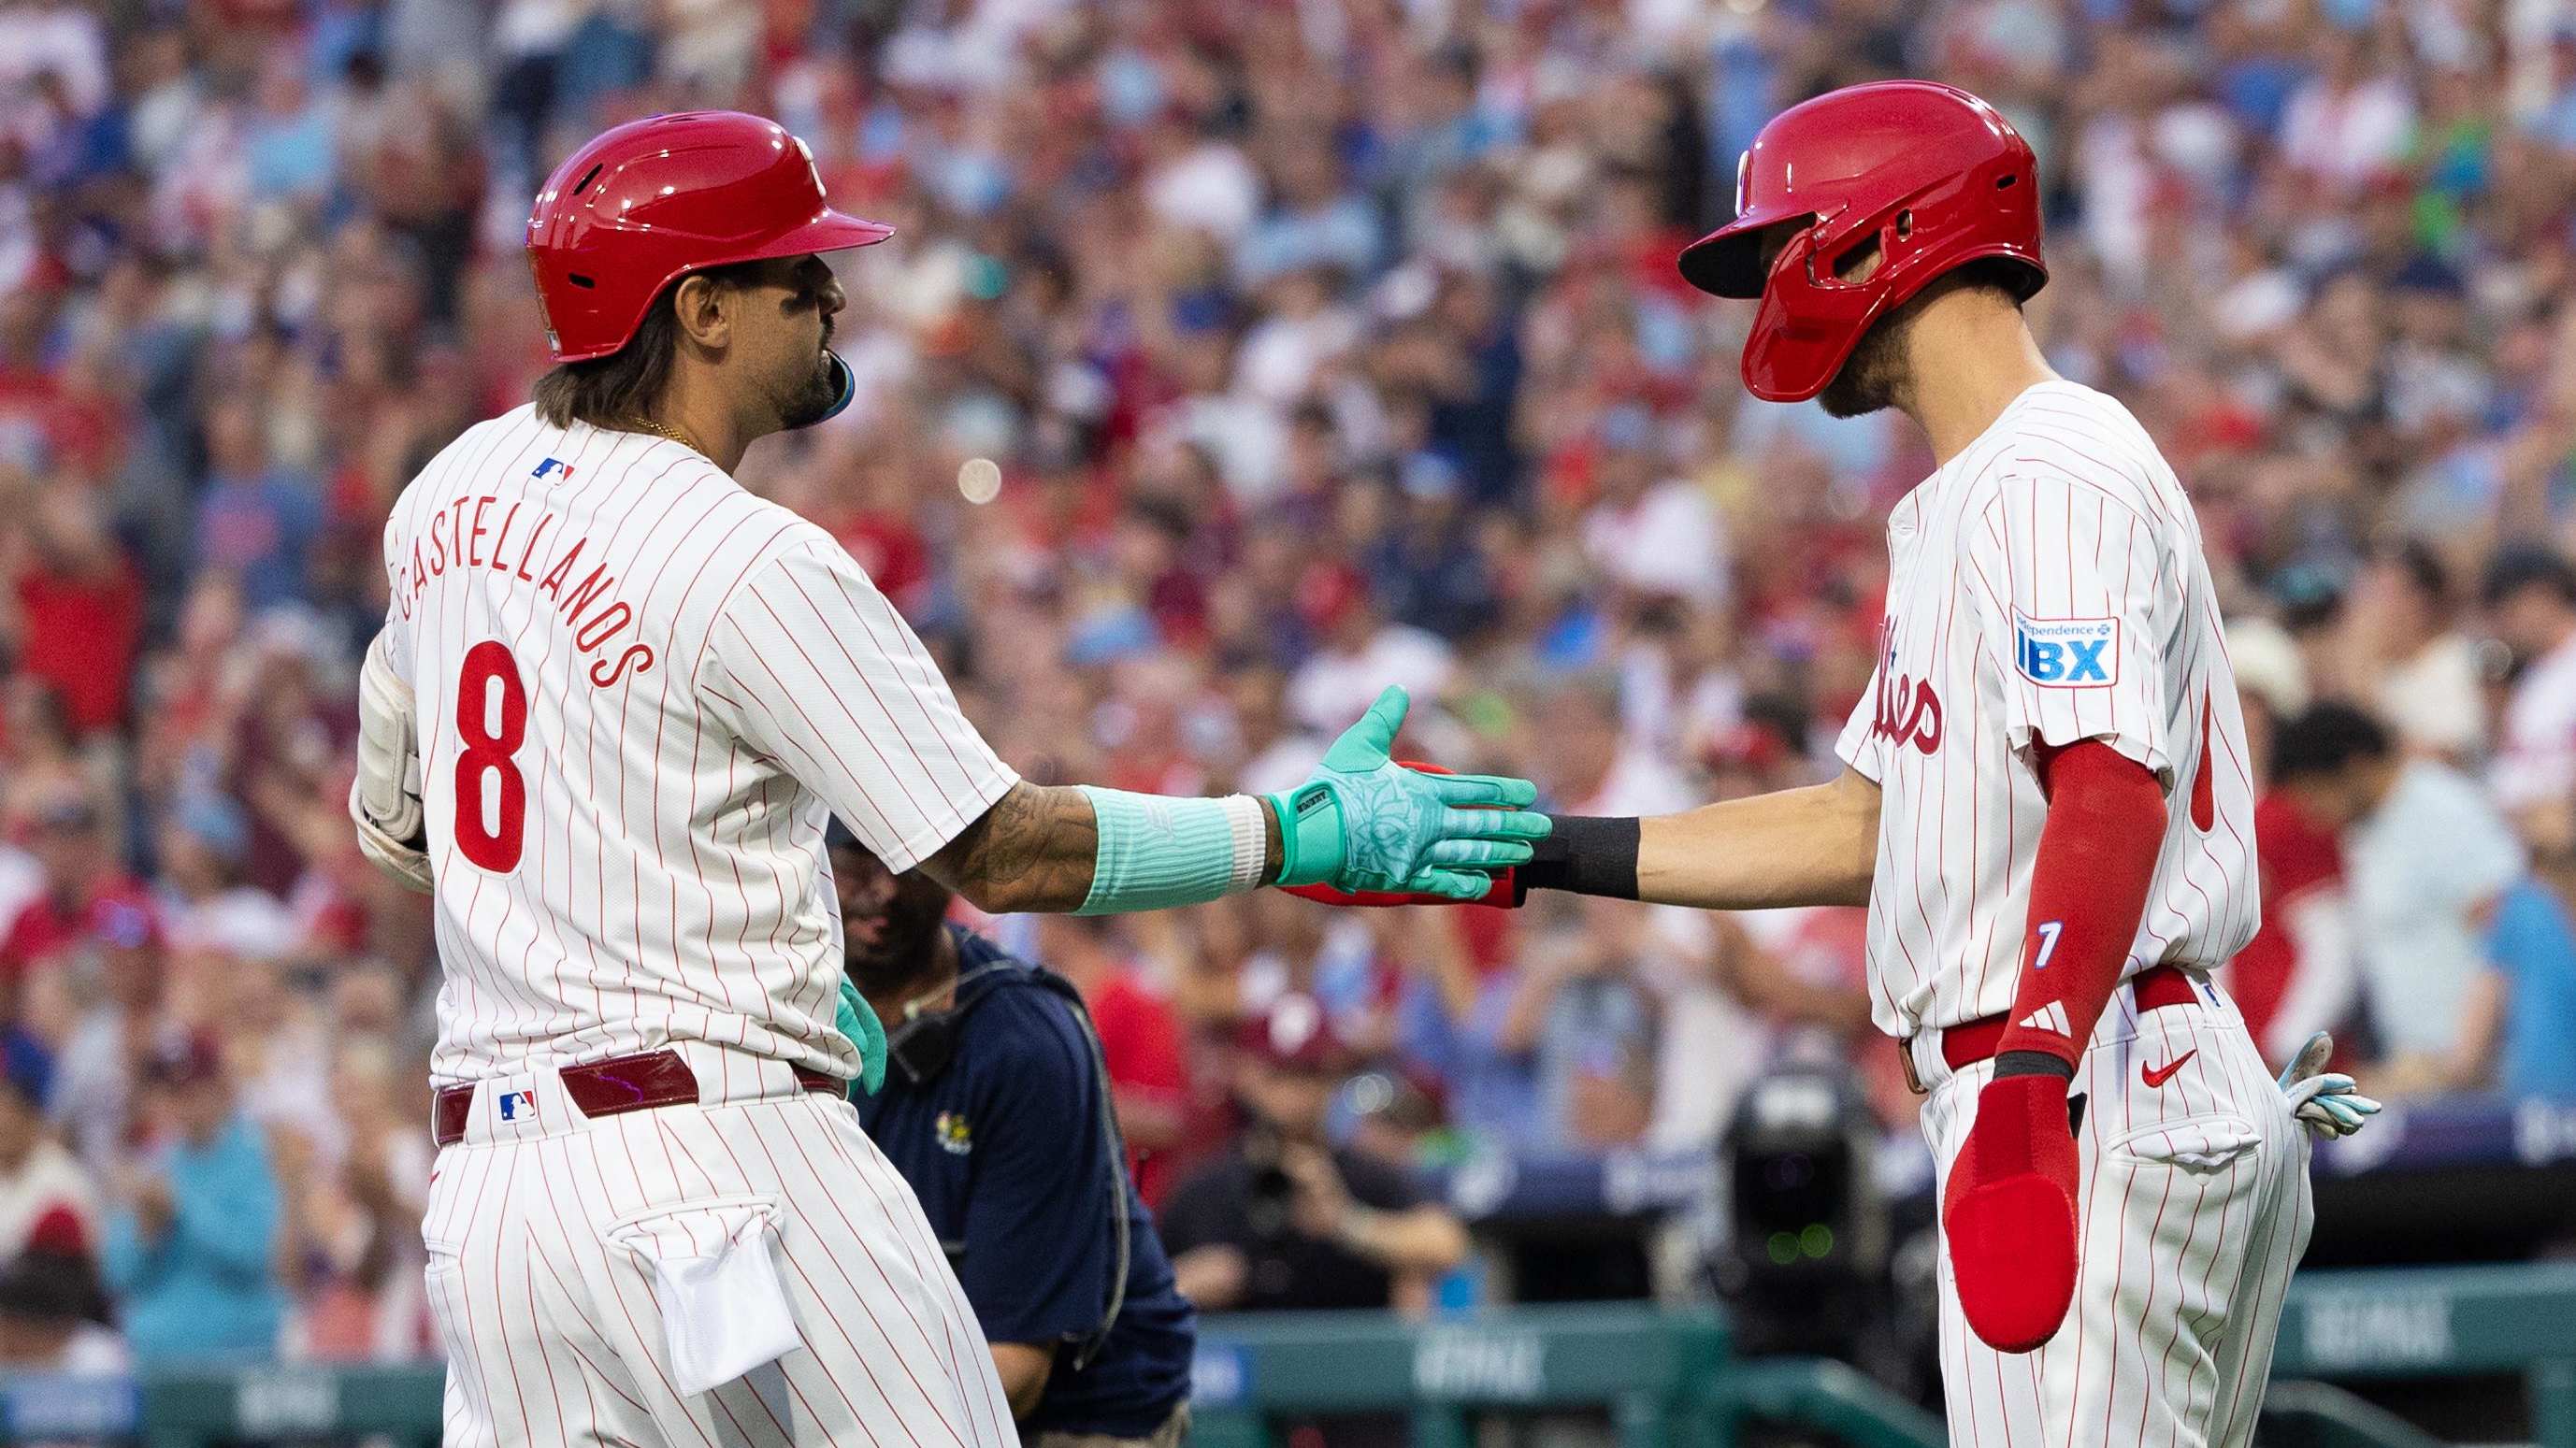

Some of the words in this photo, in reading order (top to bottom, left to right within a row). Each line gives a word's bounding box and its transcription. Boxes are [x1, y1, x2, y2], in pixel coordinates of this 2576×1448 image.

[398, 495, 655, 689] CASTELLANOS
[2018, 626, 2109, 681] IBX
[454, 640, 528, 873] 8
[2035, 919, 2065, 969] 7
